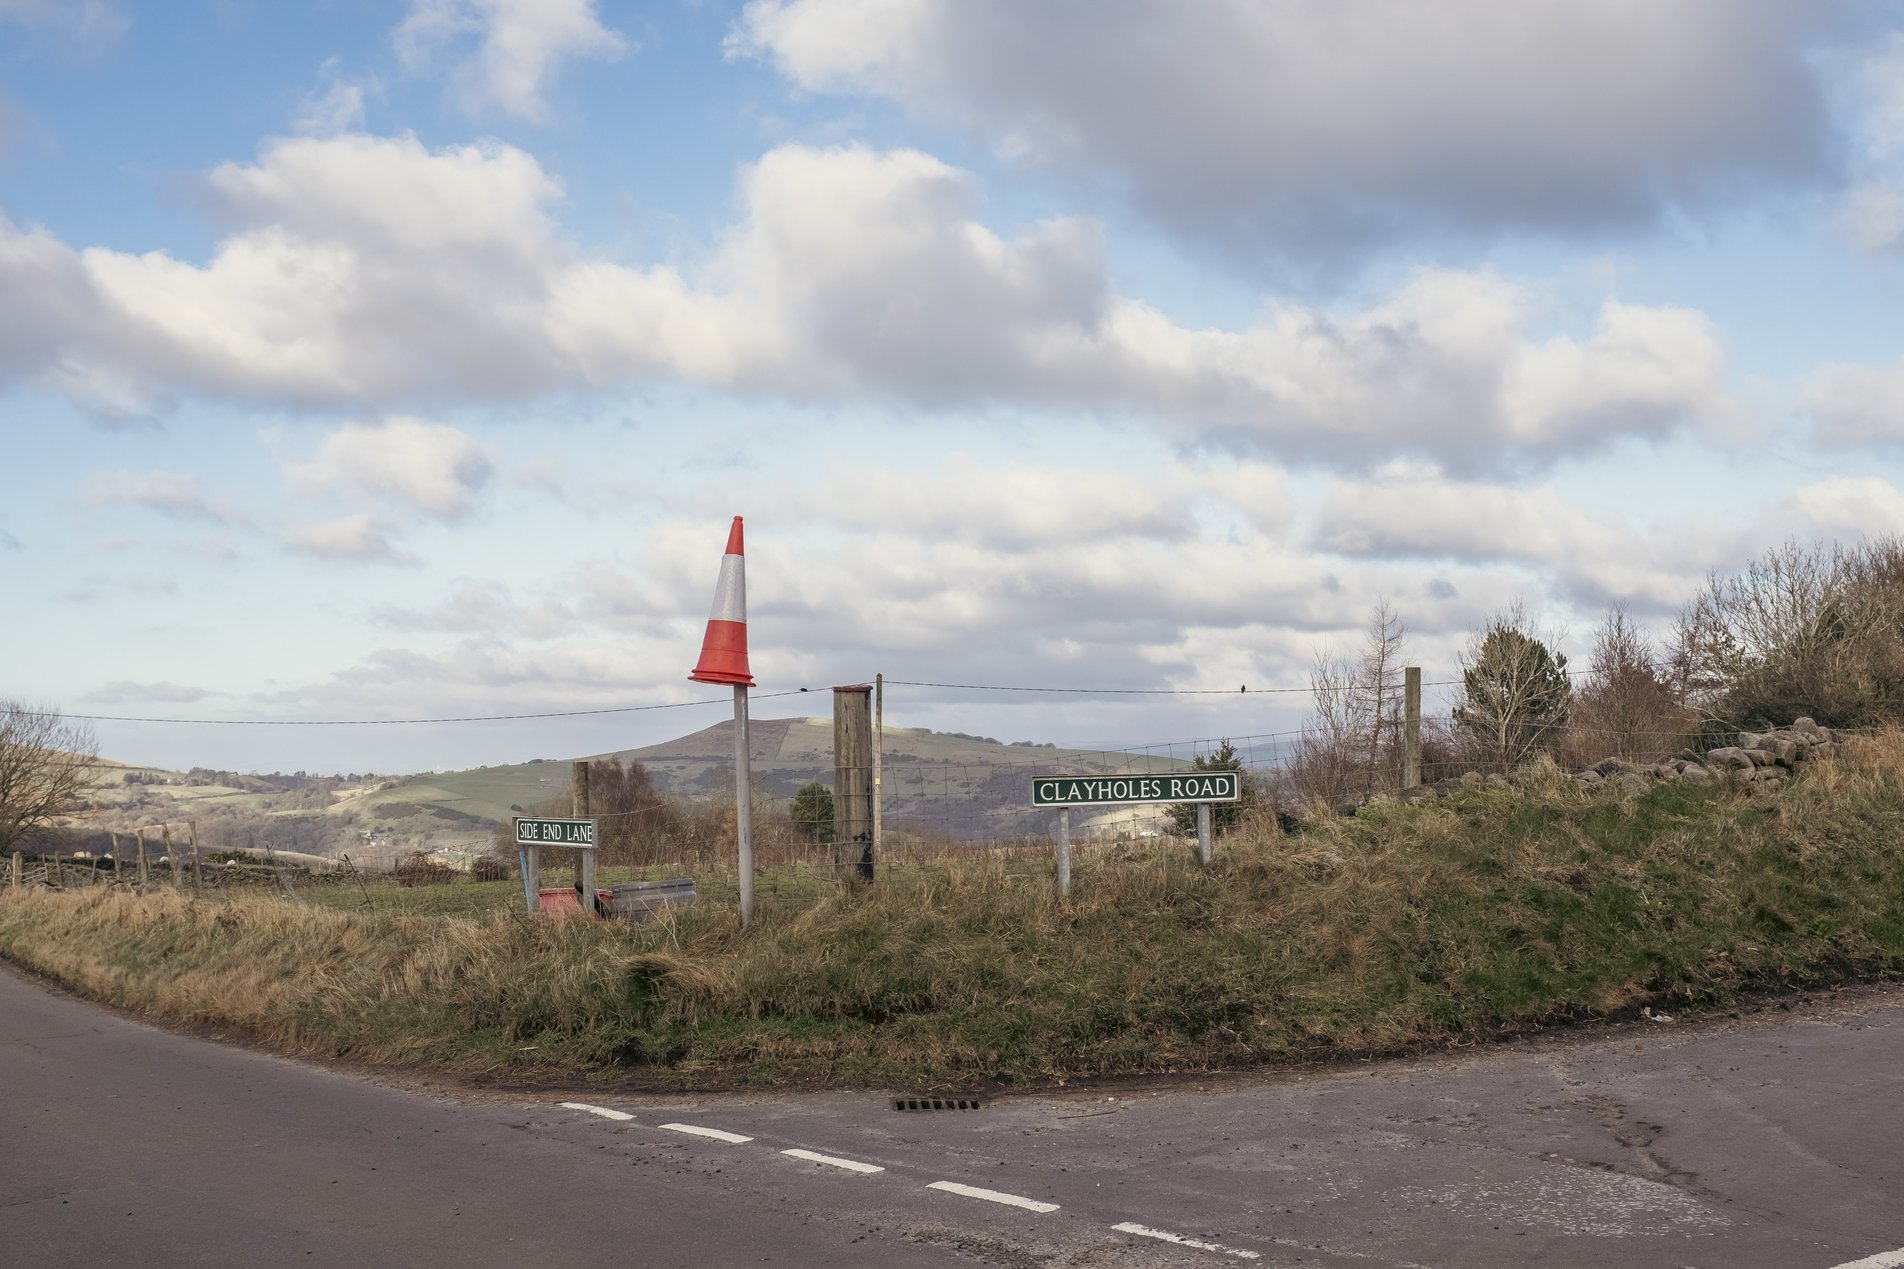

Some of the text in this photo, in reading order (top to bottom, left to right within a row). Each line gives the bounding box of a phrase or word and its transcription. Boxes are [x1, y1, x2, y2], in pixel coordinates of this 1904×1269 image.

[1040, 778, 1230, 801] CLAYHOLES ROAD
[520, 823, 592, 842] SIDE END LANE
